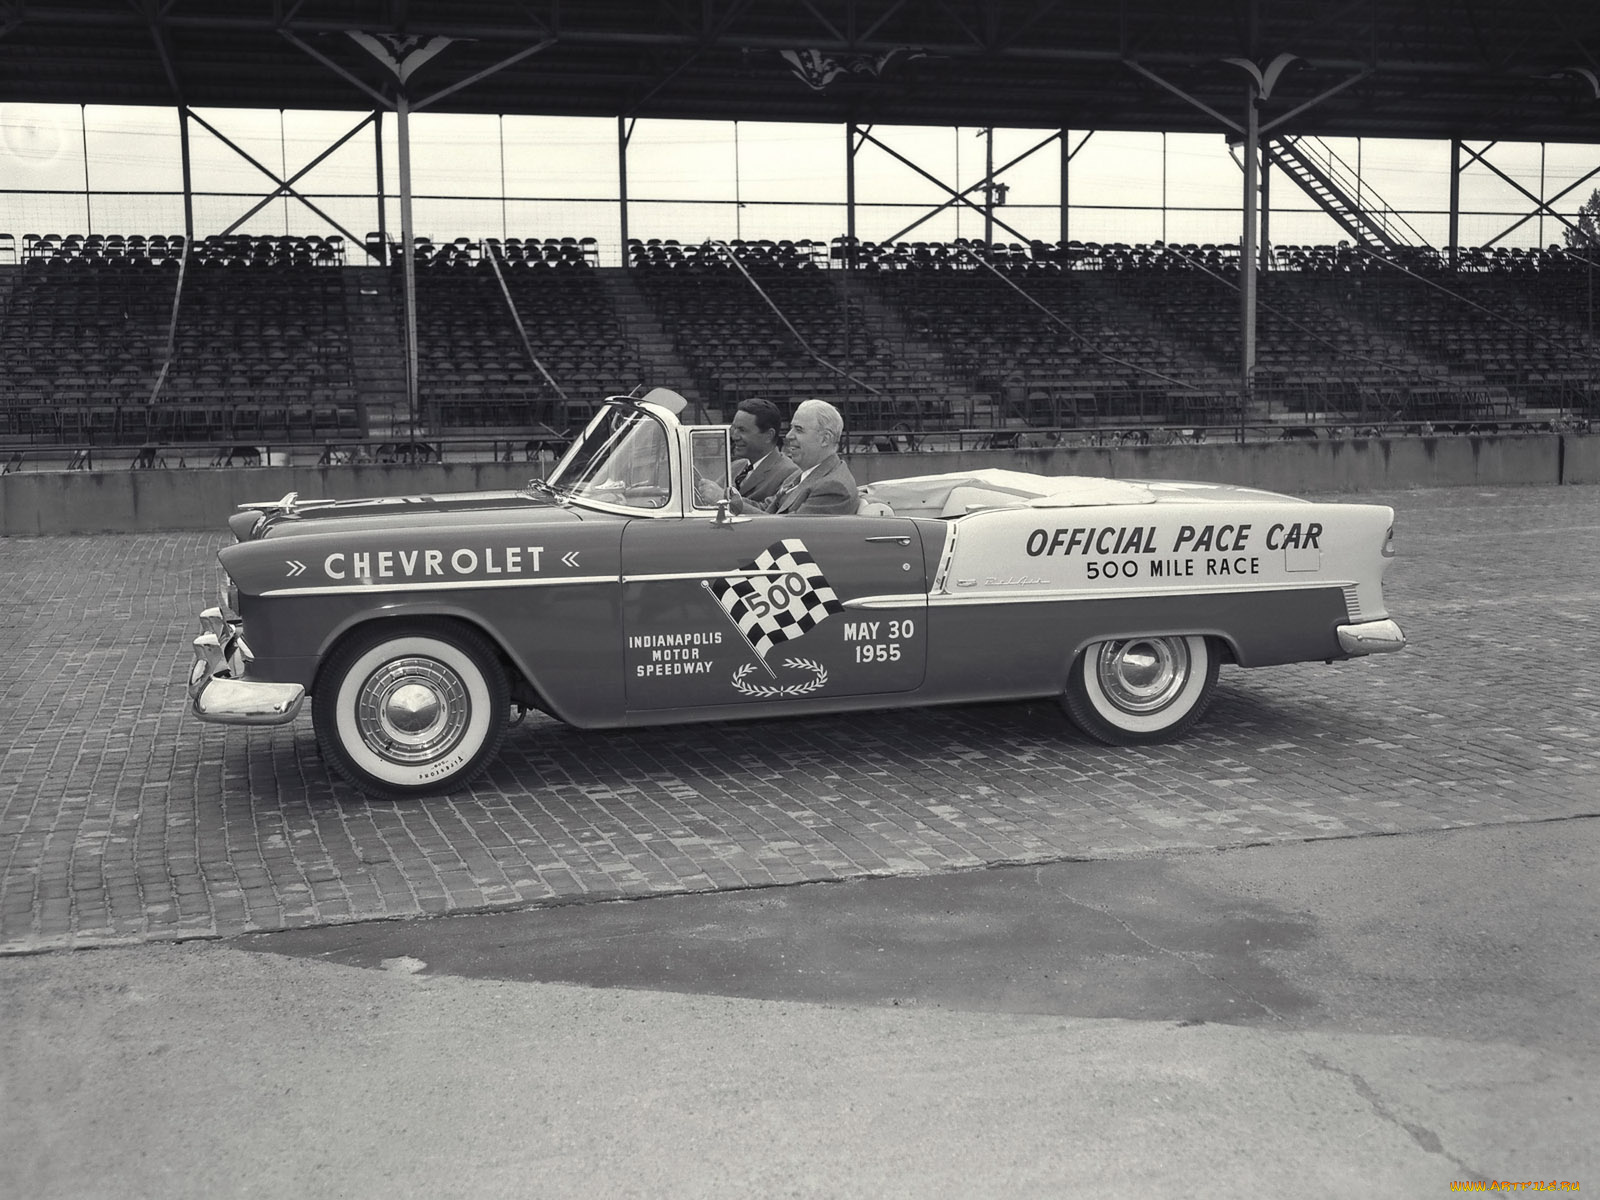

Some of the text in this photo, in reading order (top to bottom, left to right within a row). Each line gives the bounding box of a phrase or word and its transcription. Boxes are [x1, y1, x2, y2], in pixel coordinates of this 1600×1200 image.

[1027, 523, 1323, 556] OFFICIAL PACE CAR
[325, 547, 544, 579] CHEVROLET
[1086, 557, 1260, 579] 500 MILE RACE
[745, 572, 807, 619] 500
[629, 632, 723, 649] INDIANAPOLIS
[844, 620, 915, 641] MAY 30
[652, 648, 700, 662] MOTOR
[855, 643, 901, 663] 1955
[636, 660, 714, 677] SPEEDWAY
